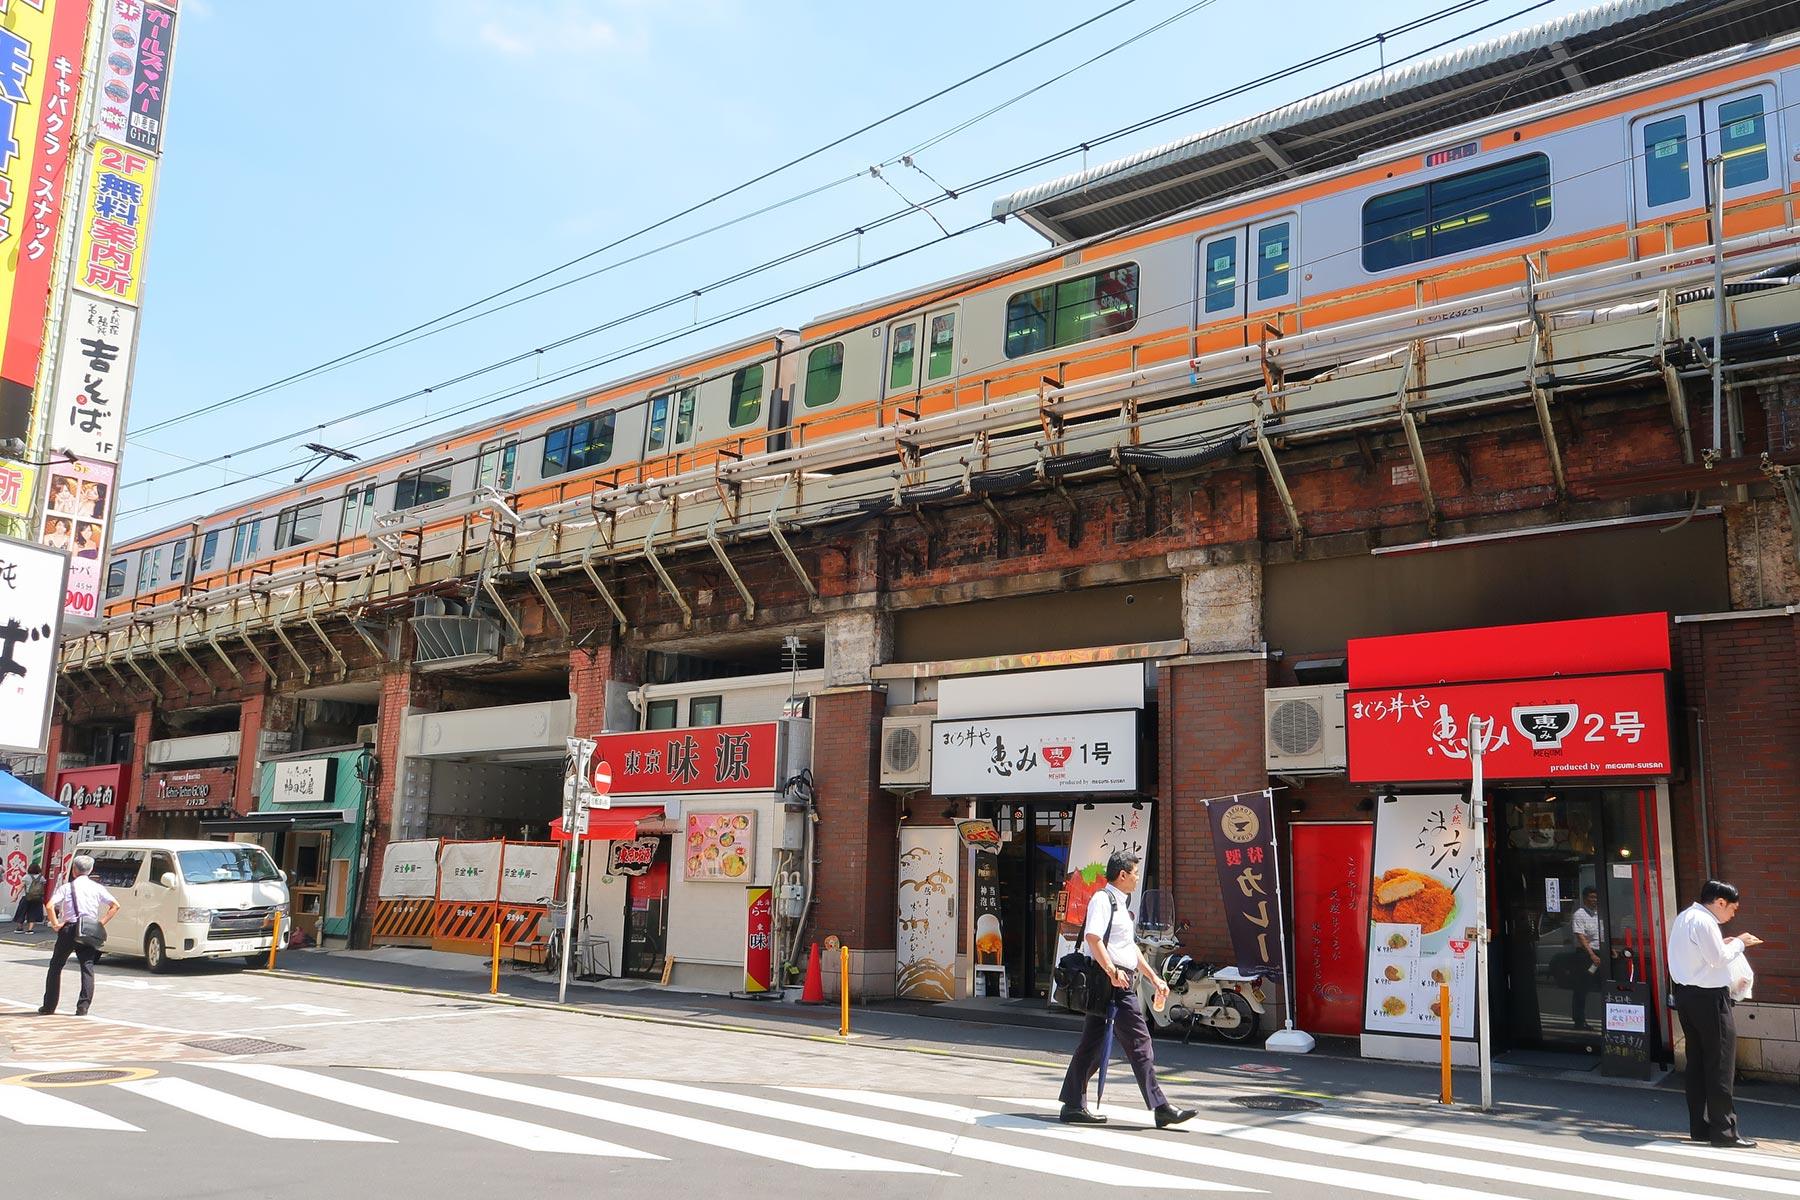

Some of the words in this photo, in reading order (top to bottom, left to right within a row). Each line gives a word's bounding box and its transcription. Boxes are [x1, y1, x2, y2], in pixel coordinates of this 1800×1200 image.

[117, 0, 140, 17] 3F
[130, 126, 155, 147] Girls
[100, 148, 147, 175] 2F
[84, 172, 142, 296] 無料案内所
[874, 328, 880, 337] 3
[70, 338, 120, 433] 吉そば
[95, 441, 113, 454] 1F
[1532, 715, 1559, 740] 恵み
[1583, 711, 1646, 743] 2号
[624, 749, 662, 776] 東京
[667, 731, 751, 785] 味源
[988, 735, 1037, 777] 恵み
[1080, 741, 1112, 765] 1号
[1532, 749, 1563, 758] MEGUMI
[1550, 763, 1588, 773] produced
[1590, 762, 1601, 772] by
